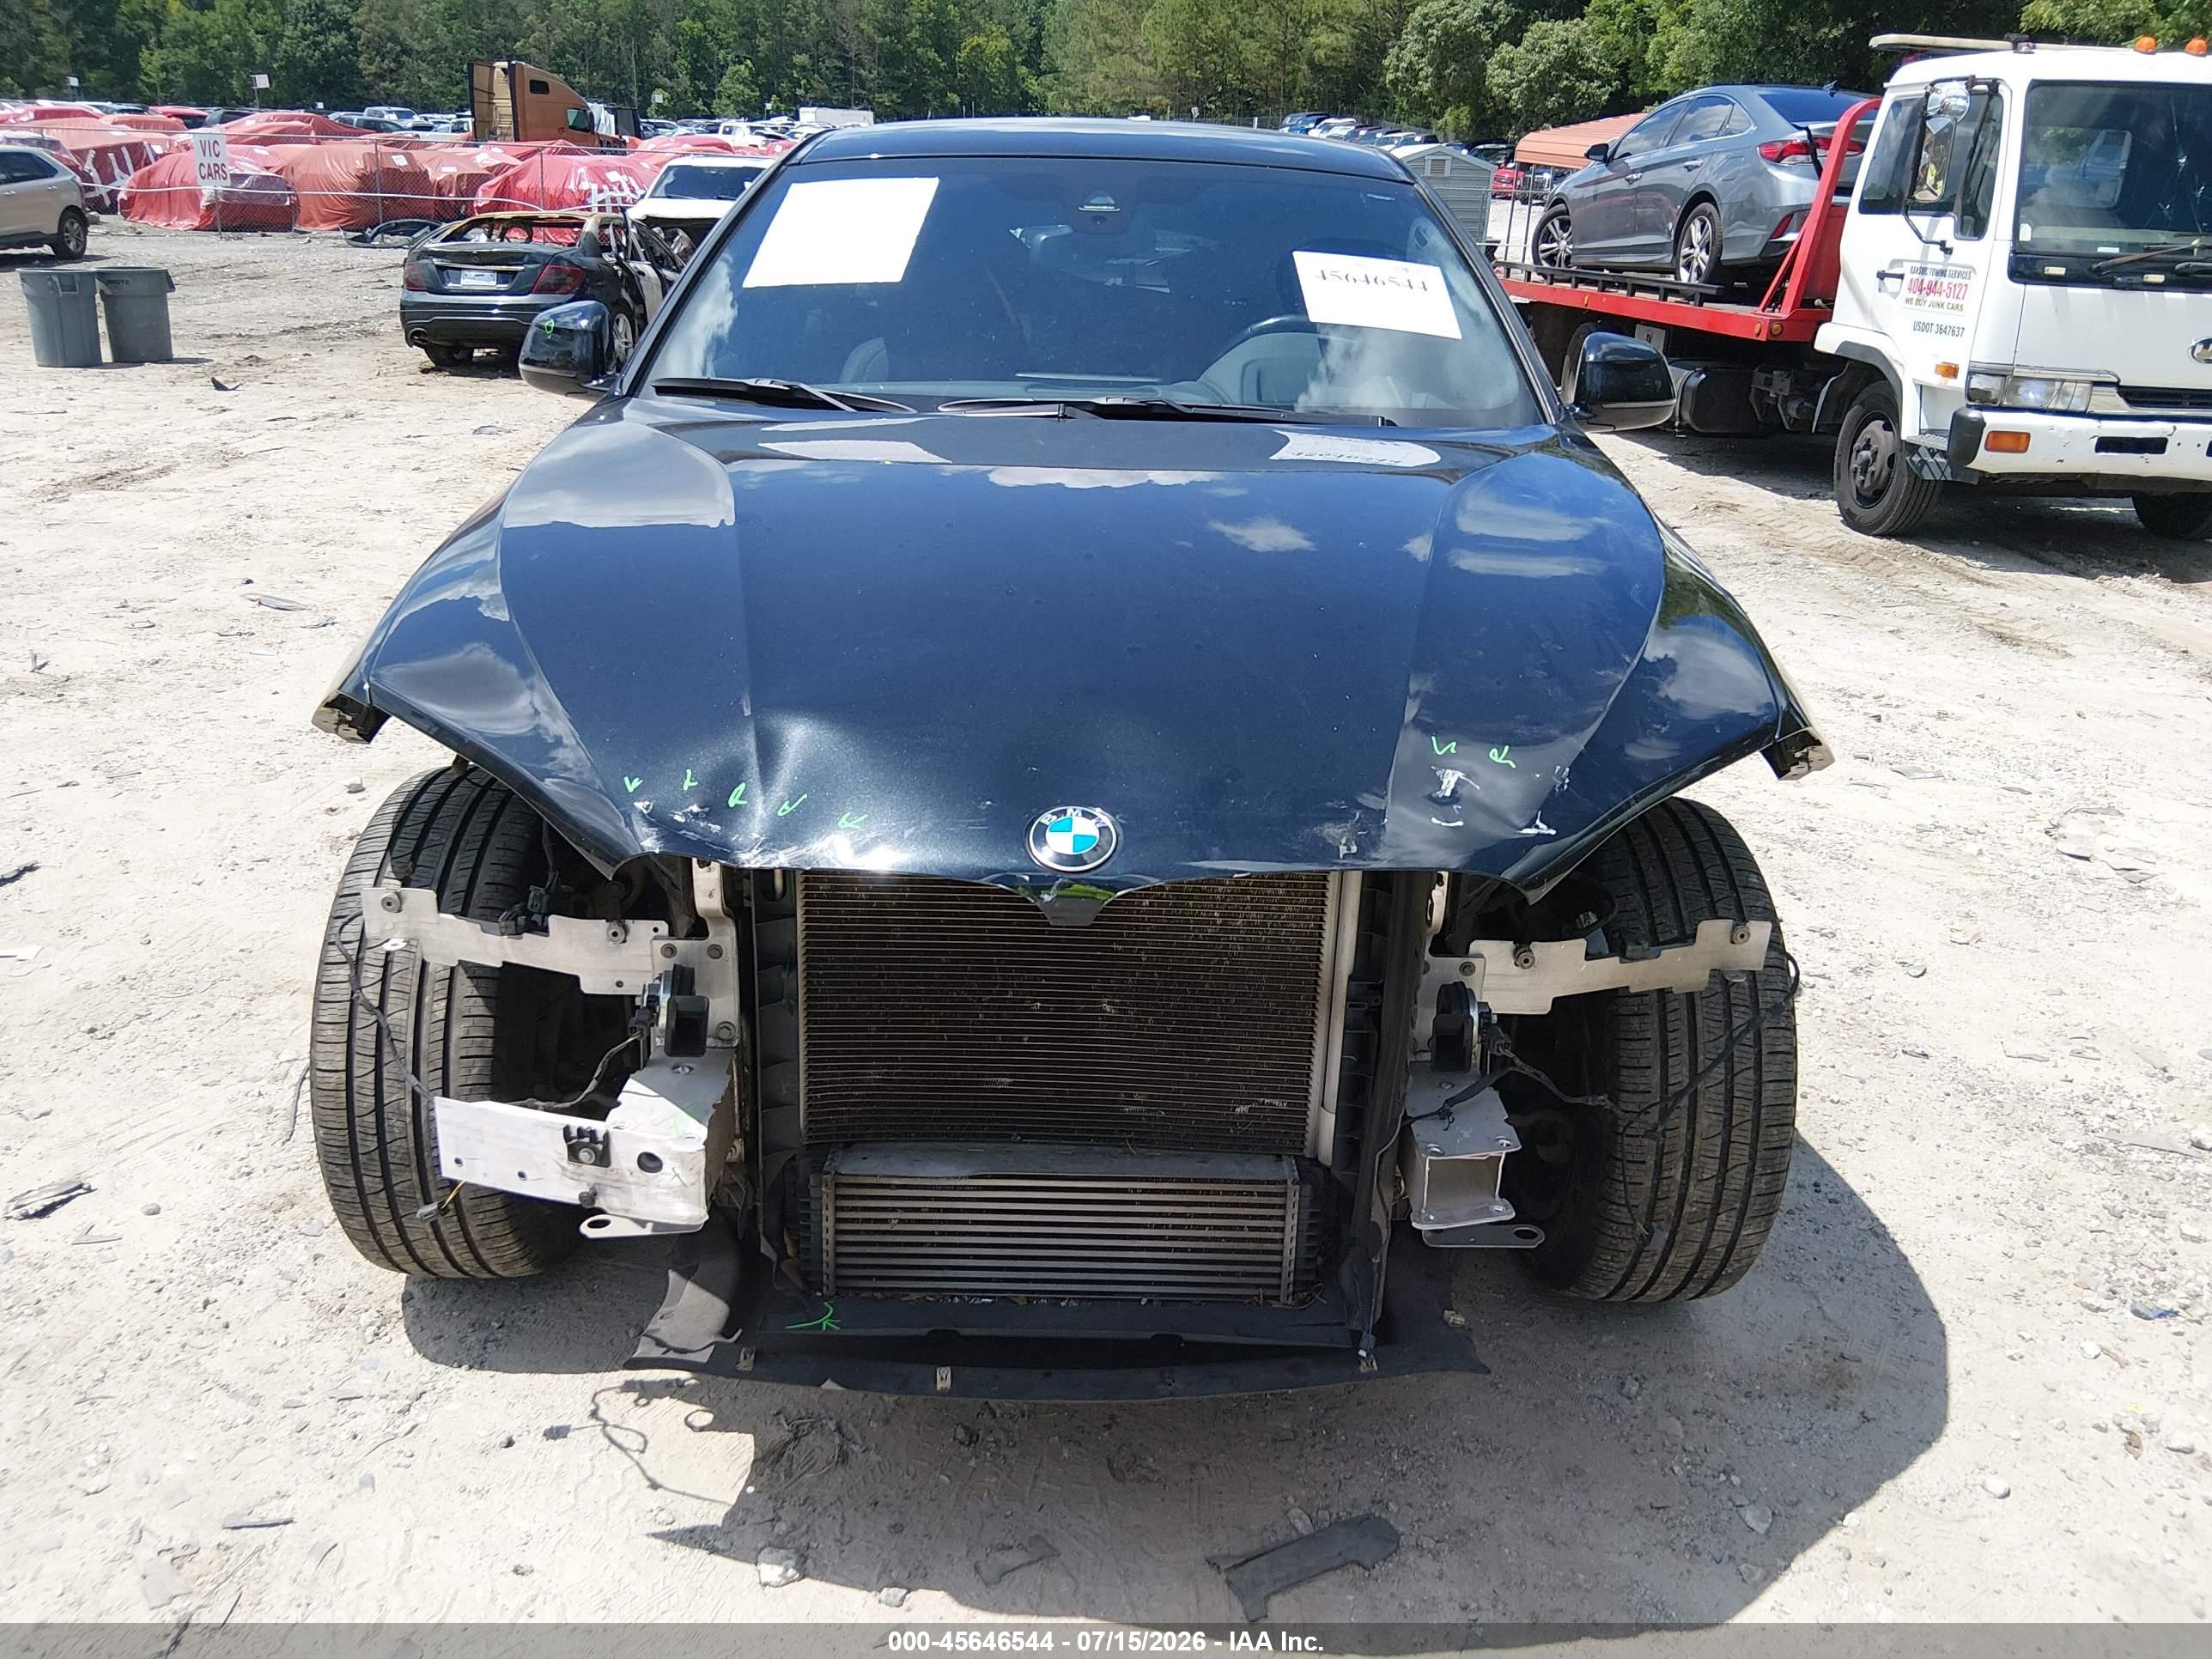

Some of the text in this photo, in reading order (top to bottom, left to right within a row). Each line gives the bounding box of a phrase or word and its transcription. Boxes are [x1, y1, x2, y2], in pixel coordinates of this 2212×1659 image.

[199, 140, 221, 158] VIC
[198, 161, 228, 180] CARS
[1948, 269, 1972, 281] SERVICES
[1906, 276, 1969, 301] 404-944-5127
[1905, 296, 1964, 312] WE BUY JUNK CARS
[1912, 320, 1966, 337] USDOT 3647637
